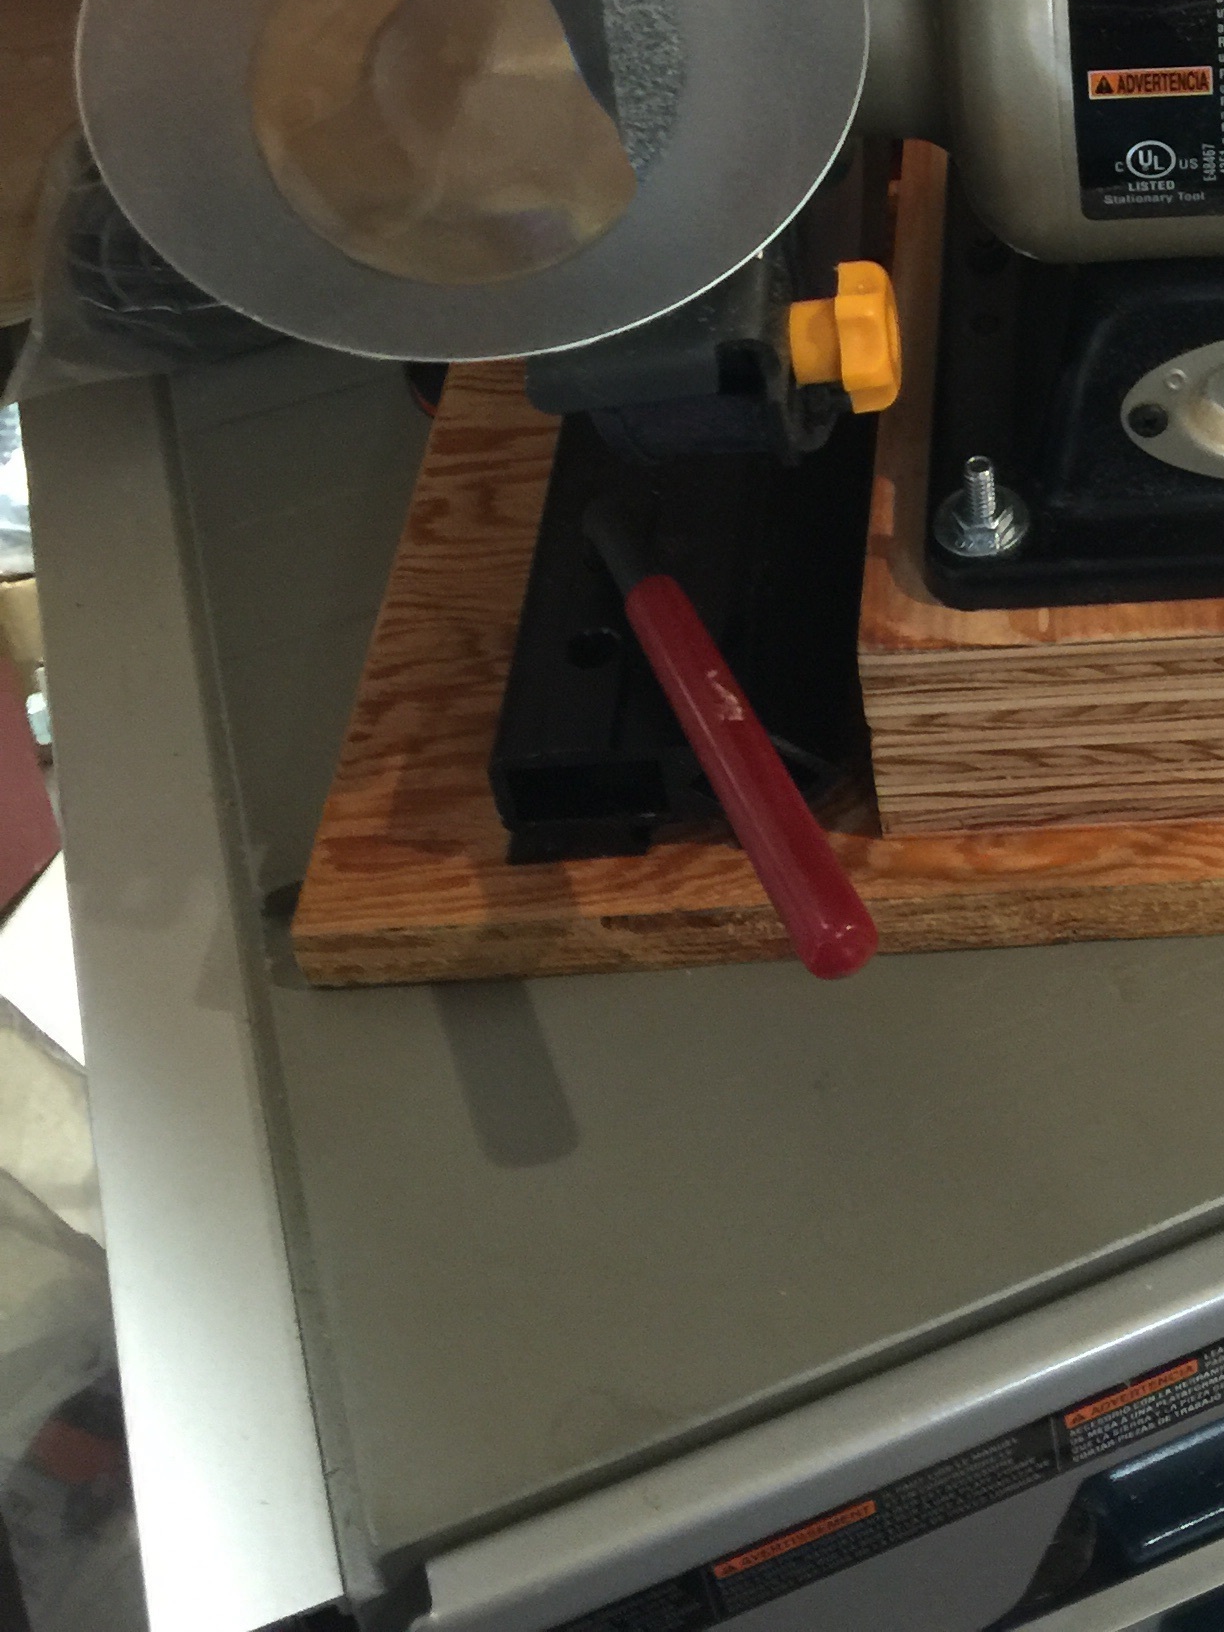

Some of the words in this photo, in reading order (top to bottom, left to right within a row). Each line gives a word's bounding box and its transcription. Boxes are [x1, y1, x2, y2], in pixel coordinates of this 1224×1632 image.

[1117, 71, 1209, 94] ADVERTENCIA
[1128, 180, 1175, 191] LISTED
[1104, 194, 1173, 204] Stationary
[1178, 192, 1204, 201] Tool
